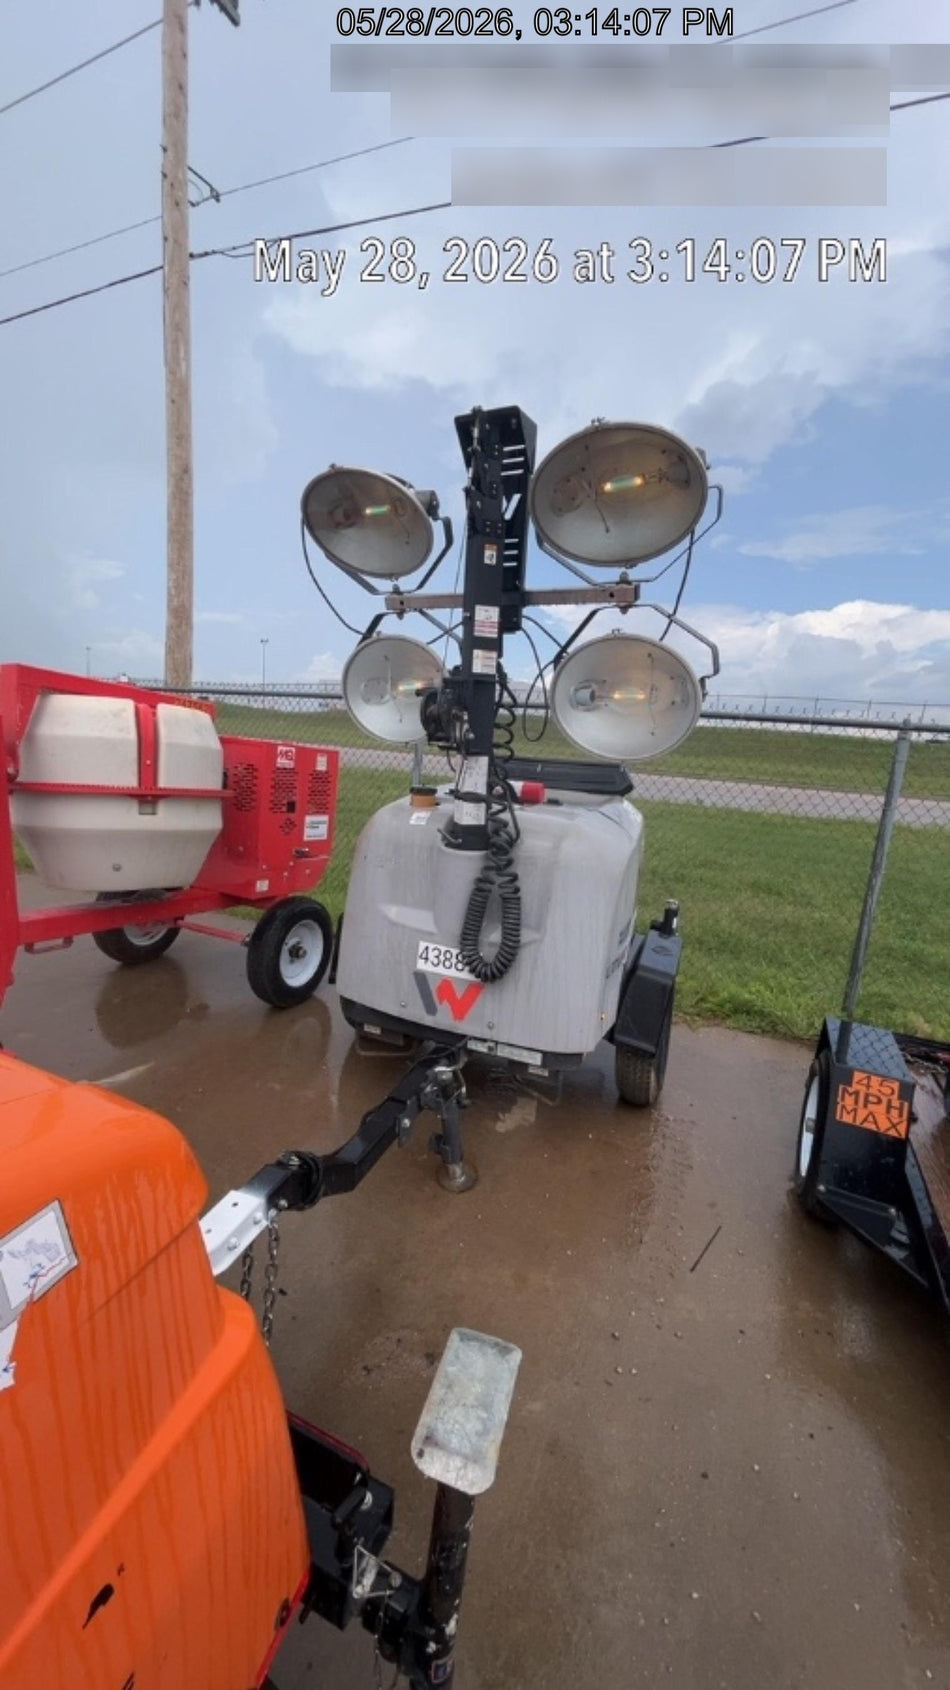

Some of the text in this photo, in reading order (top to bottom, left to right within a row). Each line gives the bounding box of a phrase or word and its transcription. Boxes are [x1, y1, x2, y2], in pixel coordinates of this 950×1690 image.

[419, 945, 466, 972] 4388
[855, 1074, 896, 1098] 45
[840, 1086, 904, 1119] MPH
[840, 1103, 905, 1137] MAX
